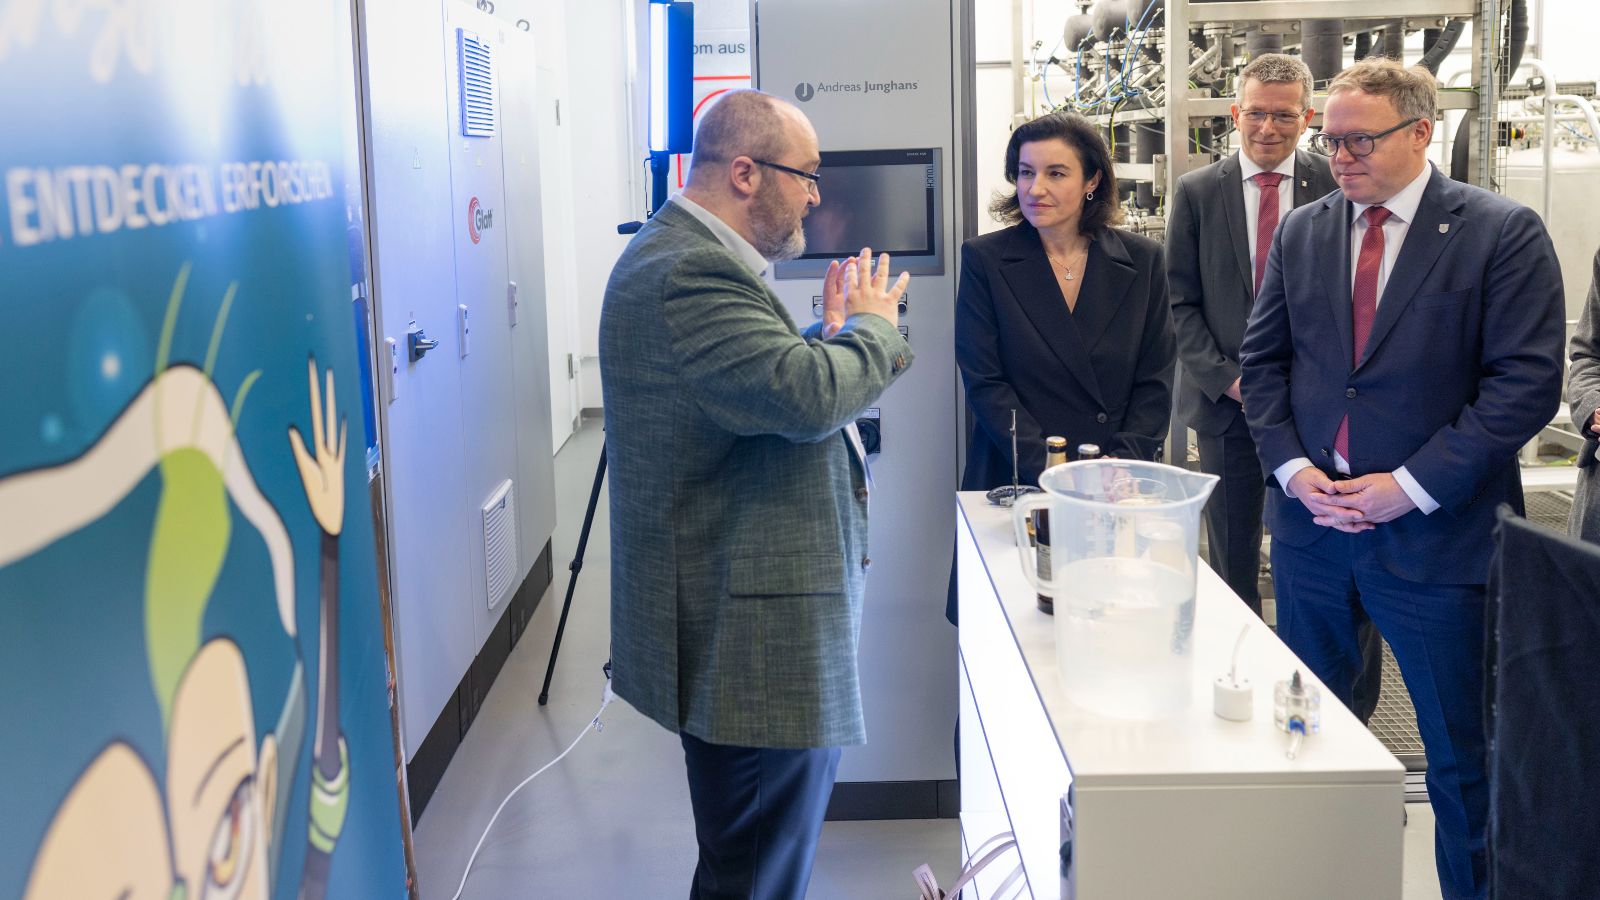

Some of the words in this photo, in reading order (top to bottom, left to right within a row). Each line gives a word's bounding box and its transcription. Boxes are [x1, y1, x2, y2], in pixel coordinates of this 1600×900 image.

[718, 43, 746, 54] aus
[817, 81, 862, 92] Andreas
[864, 80, 918, 94] Junghans
[6, 163, 218, 247] ENTDECKEN
[221, 160, 334, 212] ERFORSCHEN
[475, 208, 493, 231] Glatt
